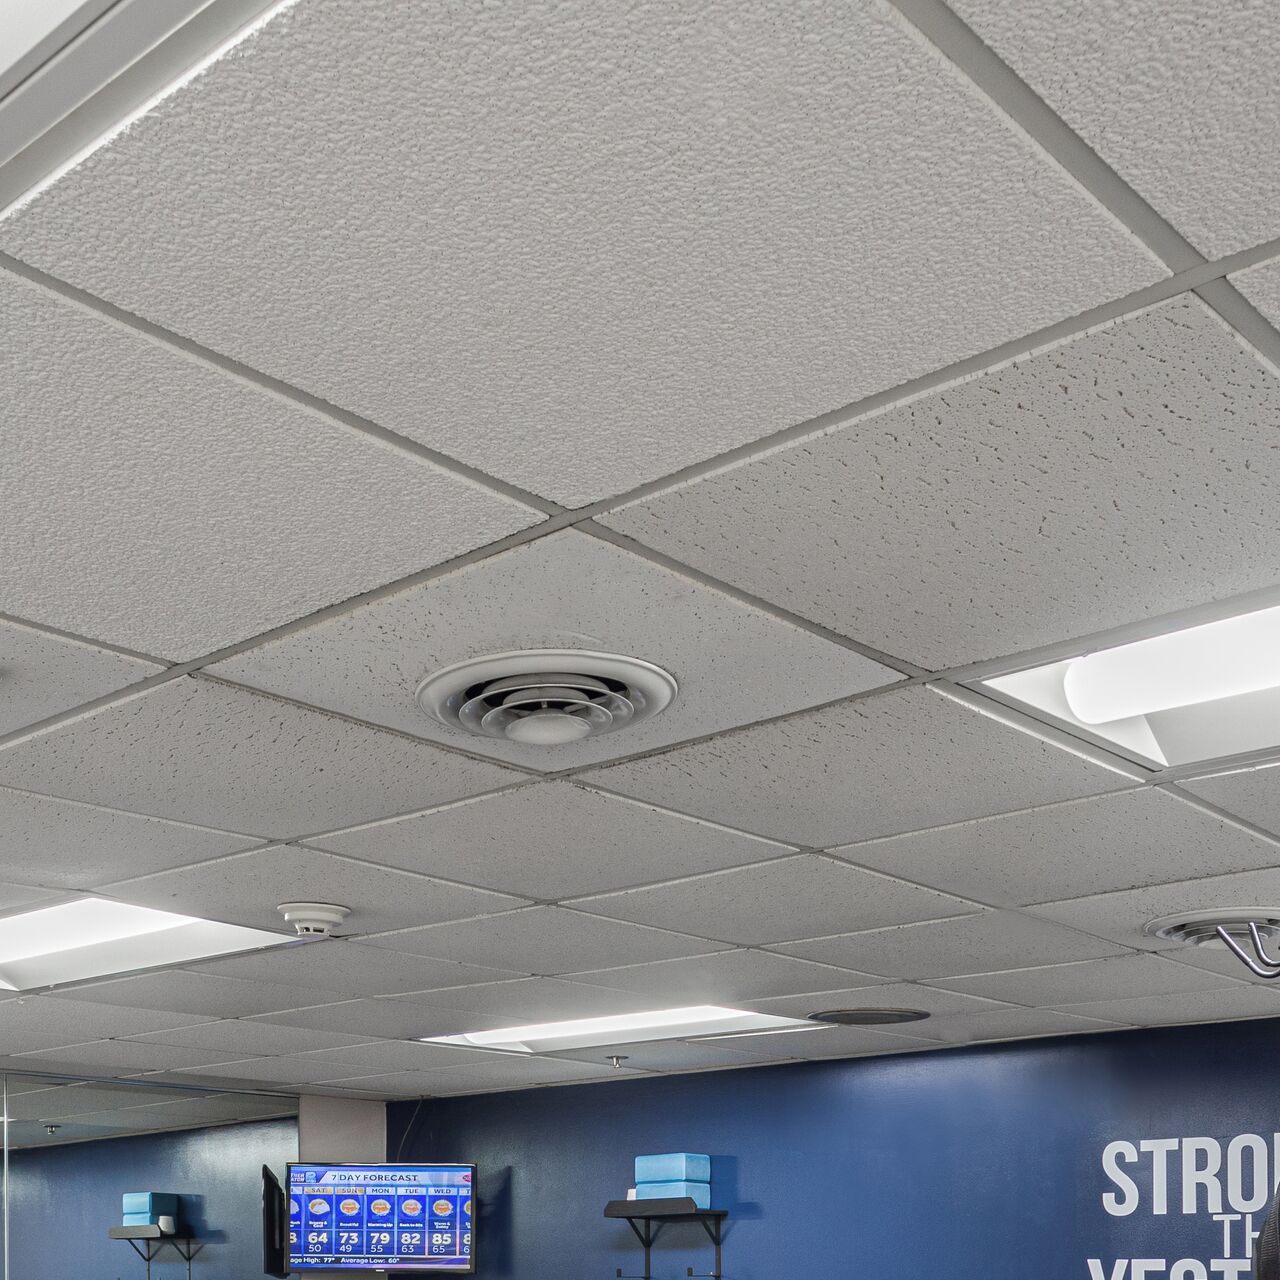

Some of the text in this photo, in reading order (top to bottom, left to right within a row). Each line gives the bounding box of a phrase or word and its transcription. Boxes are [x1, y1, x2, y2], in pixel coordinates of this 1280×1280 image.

[363, 1174, 418, 1182] FORECAST
[308, 1232, 328, 1243] 64
[339, 1232, 359, 1244] 73
[370, 1233, 390, 1244] 79
[400, 1233, 421, 1244] 82
[432, 1233, 452, 1245] 85
[308, 1244, 321, 1252] 50
[339, 1244, 352, 1252] 49
[401, 1245, 414, 1253] 63
[432, 1245, 445, 1253] 65
